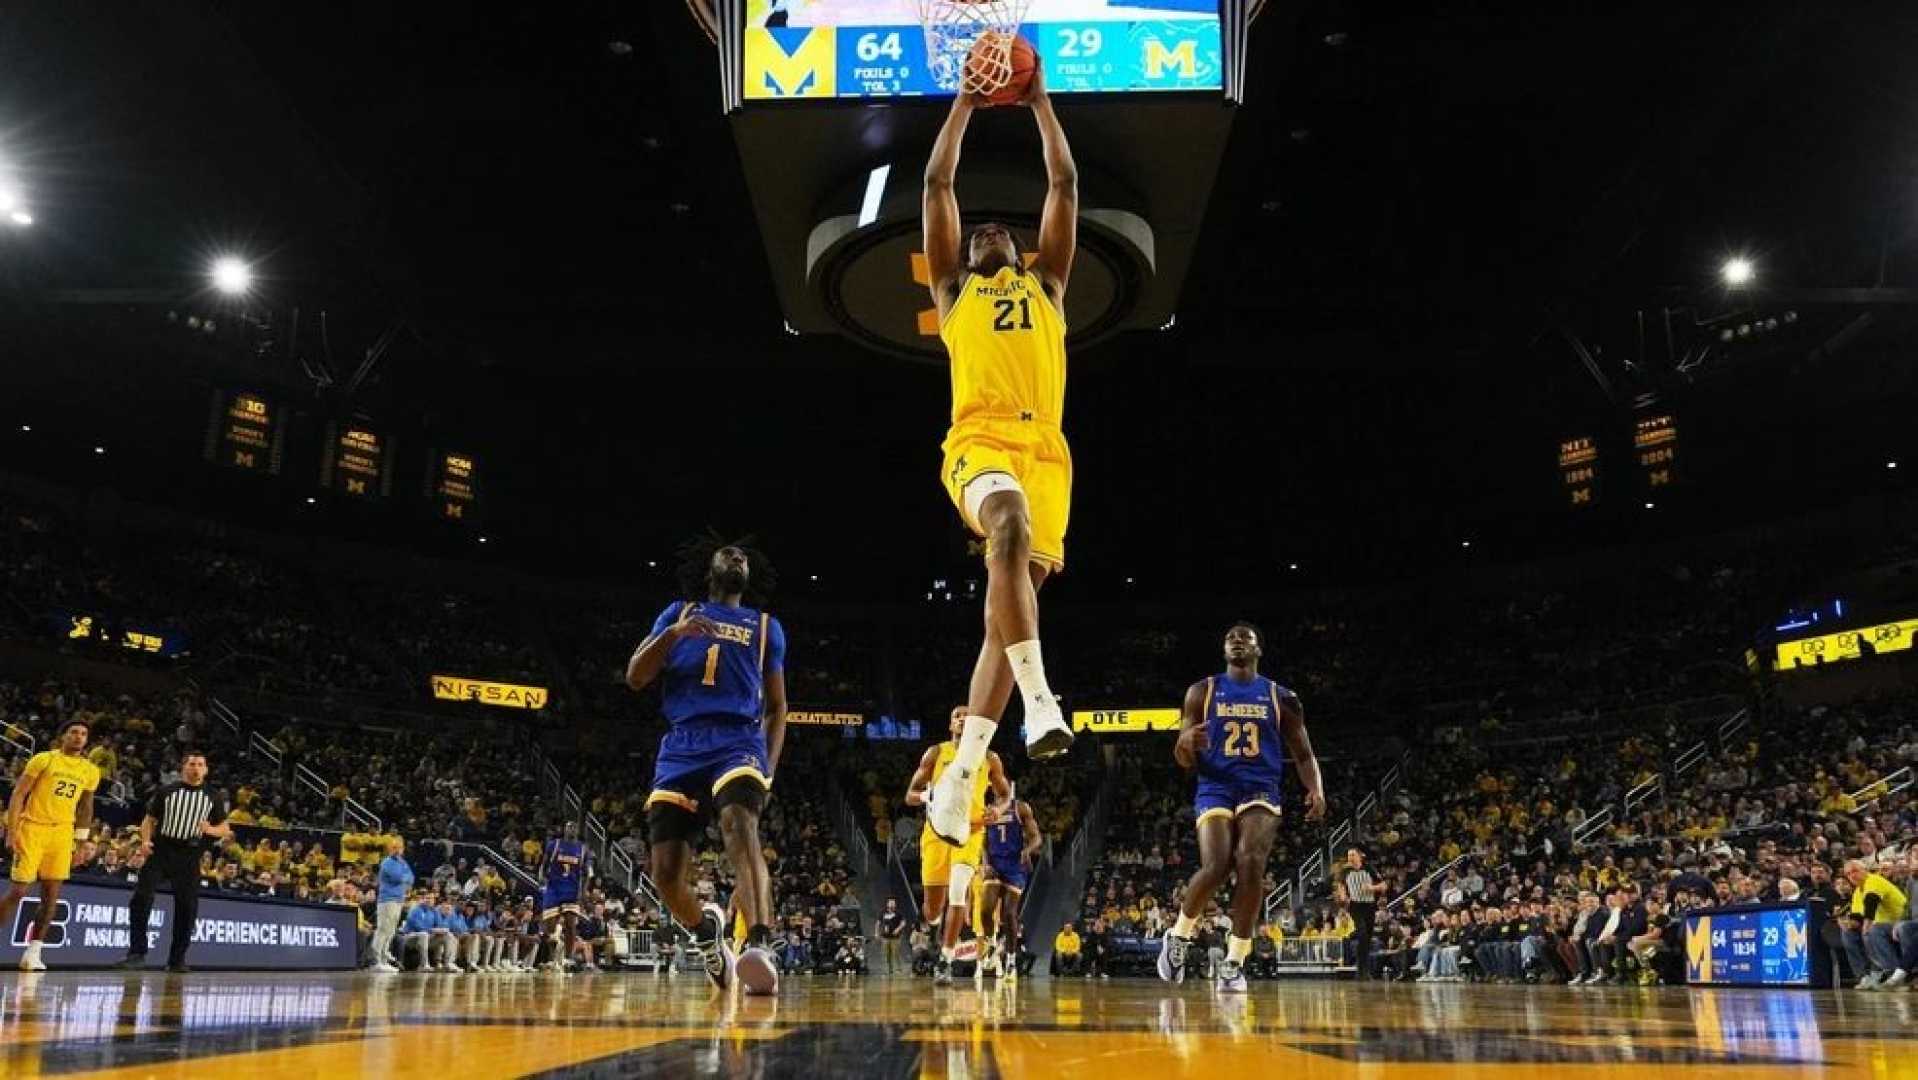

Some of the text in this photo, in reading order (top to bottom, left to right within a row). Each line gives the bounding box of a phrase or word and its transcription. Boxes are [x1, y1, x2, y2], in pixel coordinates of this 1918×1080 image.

[856, 32, 903, 61] 64
[1056, 28, 1102, 57] 29
[993, 298, 1033, 332] 21
[702, 644, 720, 686] 1
[437, 680, 540, 705] NISSAN
[1093, 711, 1128, 725] DTE
[1224, 721, 1260, 758] 23
[54, 780, 77, 799] 23
[75, 902, 114, 923] FARM
[1712, 930, 1726, 948] 64
[1762, 927, 1779, 946] 29
